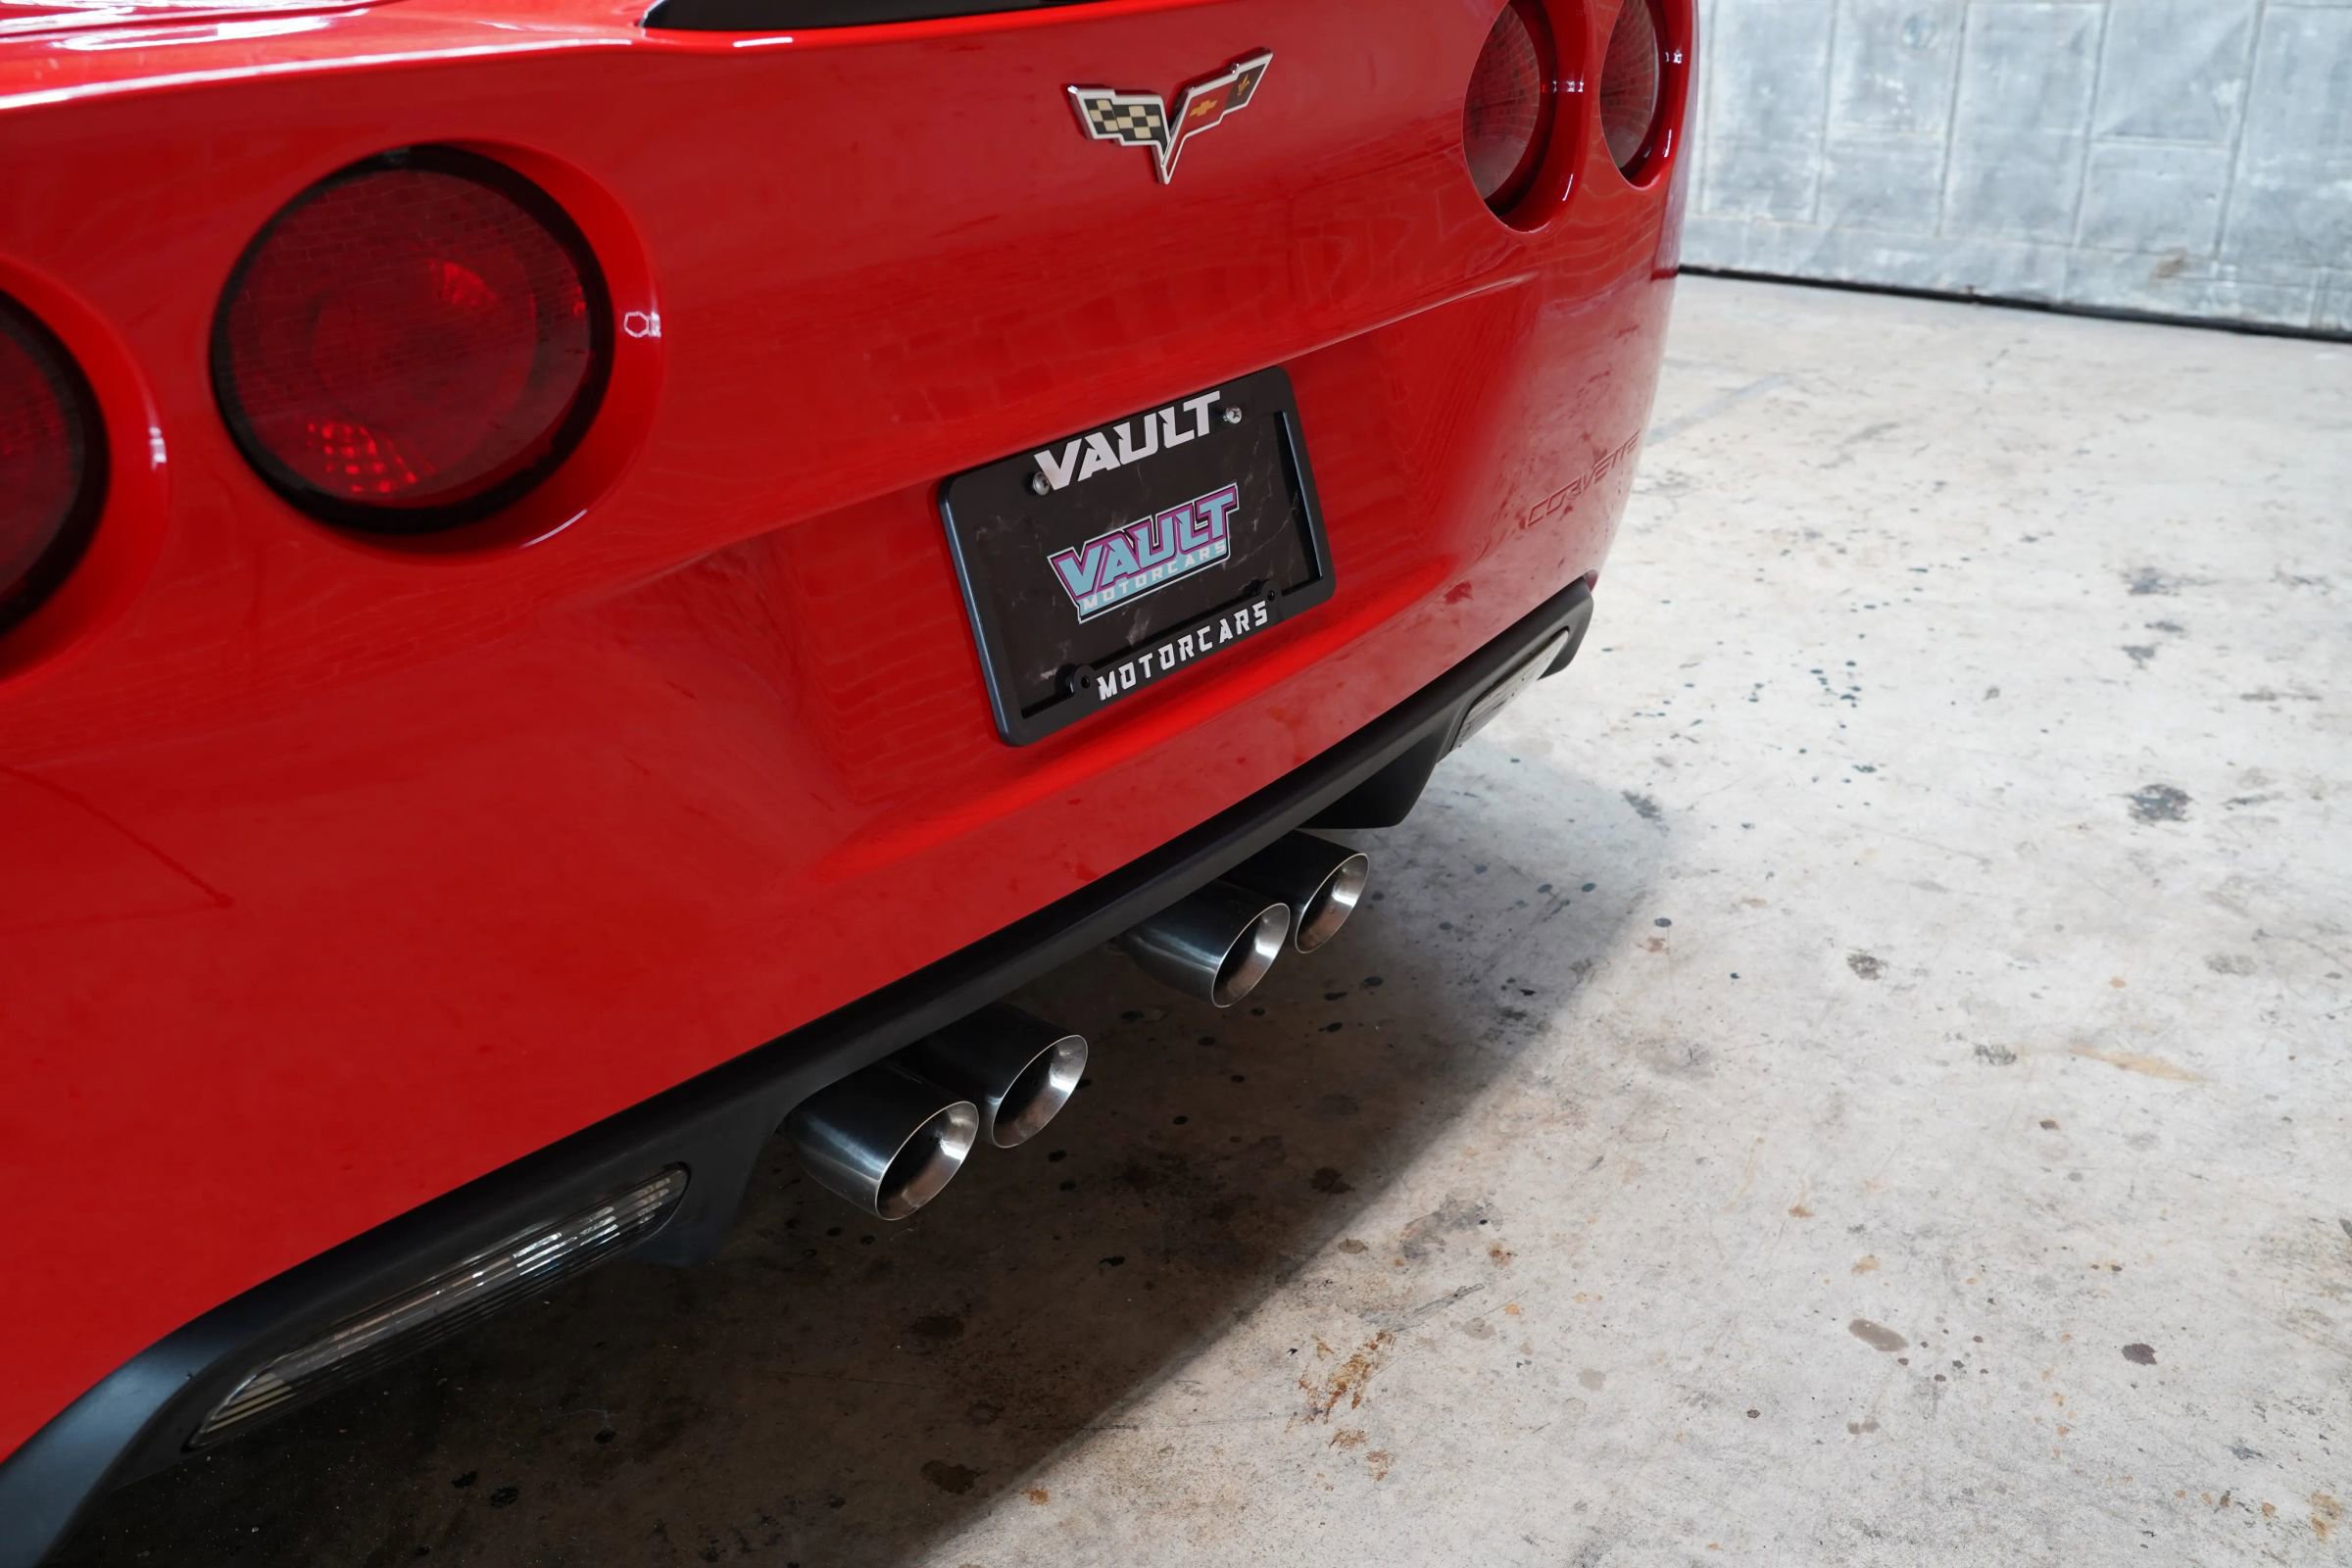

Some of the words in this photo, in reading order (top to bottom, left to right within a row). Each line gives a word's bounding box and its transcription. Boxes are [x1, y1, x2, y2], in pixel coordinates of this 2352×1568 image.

[1034, 390, 1220, 490] VAULT
[1526, 429, 1641, 526] CORVETTE
[1054, 491, 1235, 600] VAULT
[1081, 542, 1227, 612] MOTORCARS
[1097, 600, 1268, 701] MOTORCARS
